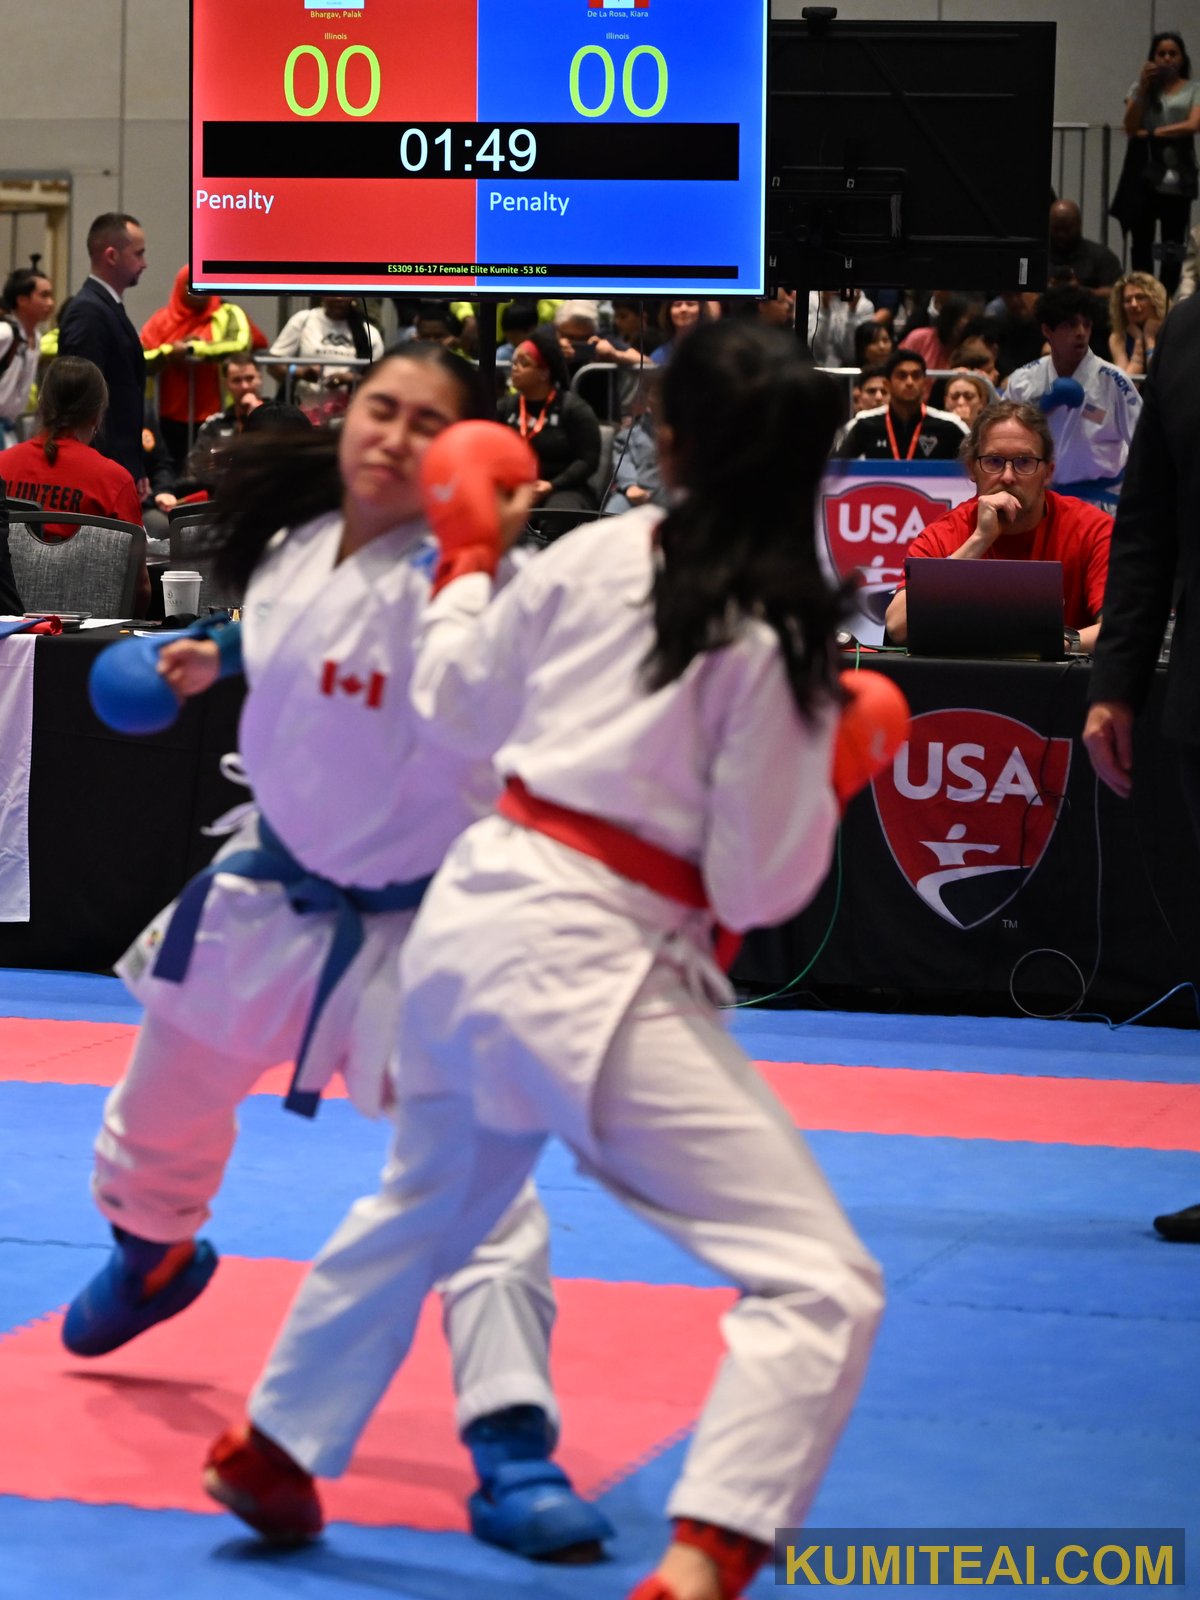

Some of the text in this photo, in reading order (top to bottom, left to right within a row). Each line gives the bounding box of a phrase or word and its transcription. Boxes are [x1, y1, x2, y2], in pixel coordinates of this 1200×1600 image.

[310, 10, 363, 20] Bhargav, Palak
[587, 10, 649, 19] De La Rosa, Kiara
[324, 32, 347, 40] Illinois
[606, 32, 629, 40] Illinois
[284, 44, 381, 117] 00
[569, 44, 668, 117] 00
[400, 127, 537, 173] 01:49
[196, 189, 275, 215] Penalty
[490, 191, 570, 216] Penalty
[387, 264, 548, 275] ES309 16-17 Female Elite Kumite -53 KG
[838, 502, 928, 544] USA
[893, 740, 1043, 806] USA
[1002, 919, 1018, 929] TM
